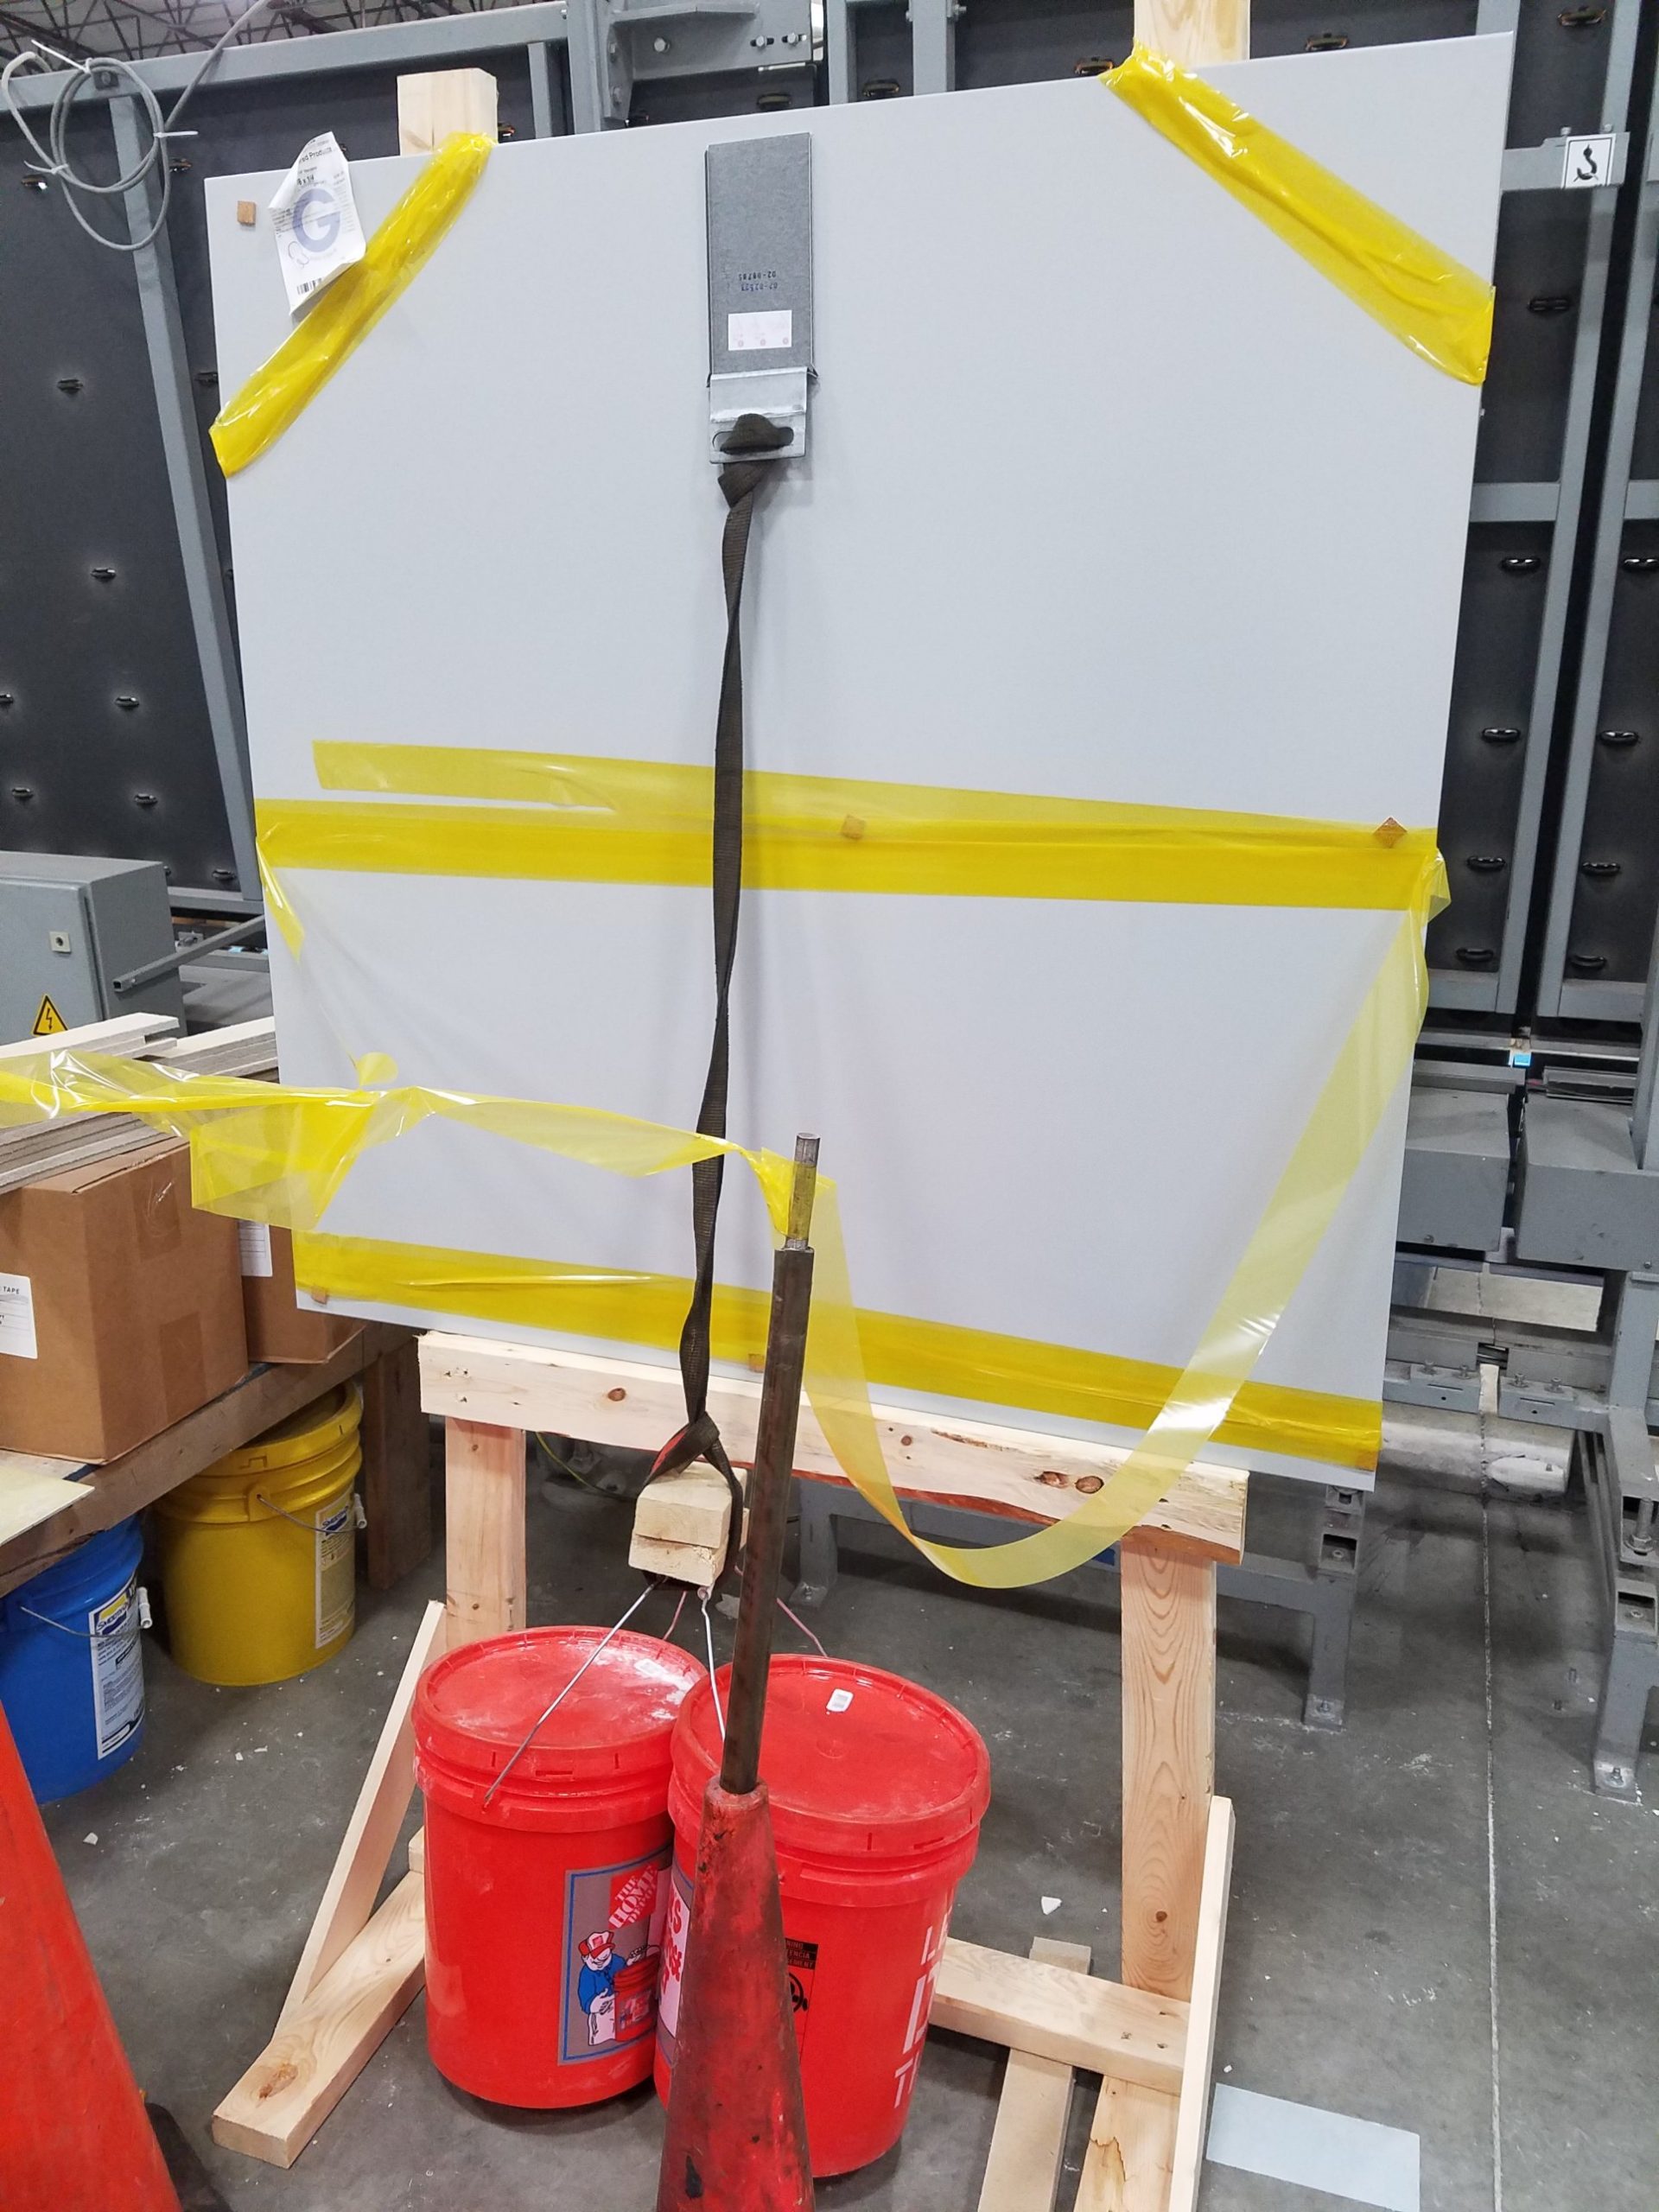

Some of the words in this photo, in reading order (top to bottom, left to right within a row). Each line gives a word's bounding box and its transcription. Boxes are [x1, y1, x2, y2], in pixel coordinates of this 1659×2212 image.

[294, 189, 341, 252] G
[3, 1286, 20, 1294] TAPE
[608, 1865, 658, 1929] HOME
[614, 1875, 637, 1901] THE
